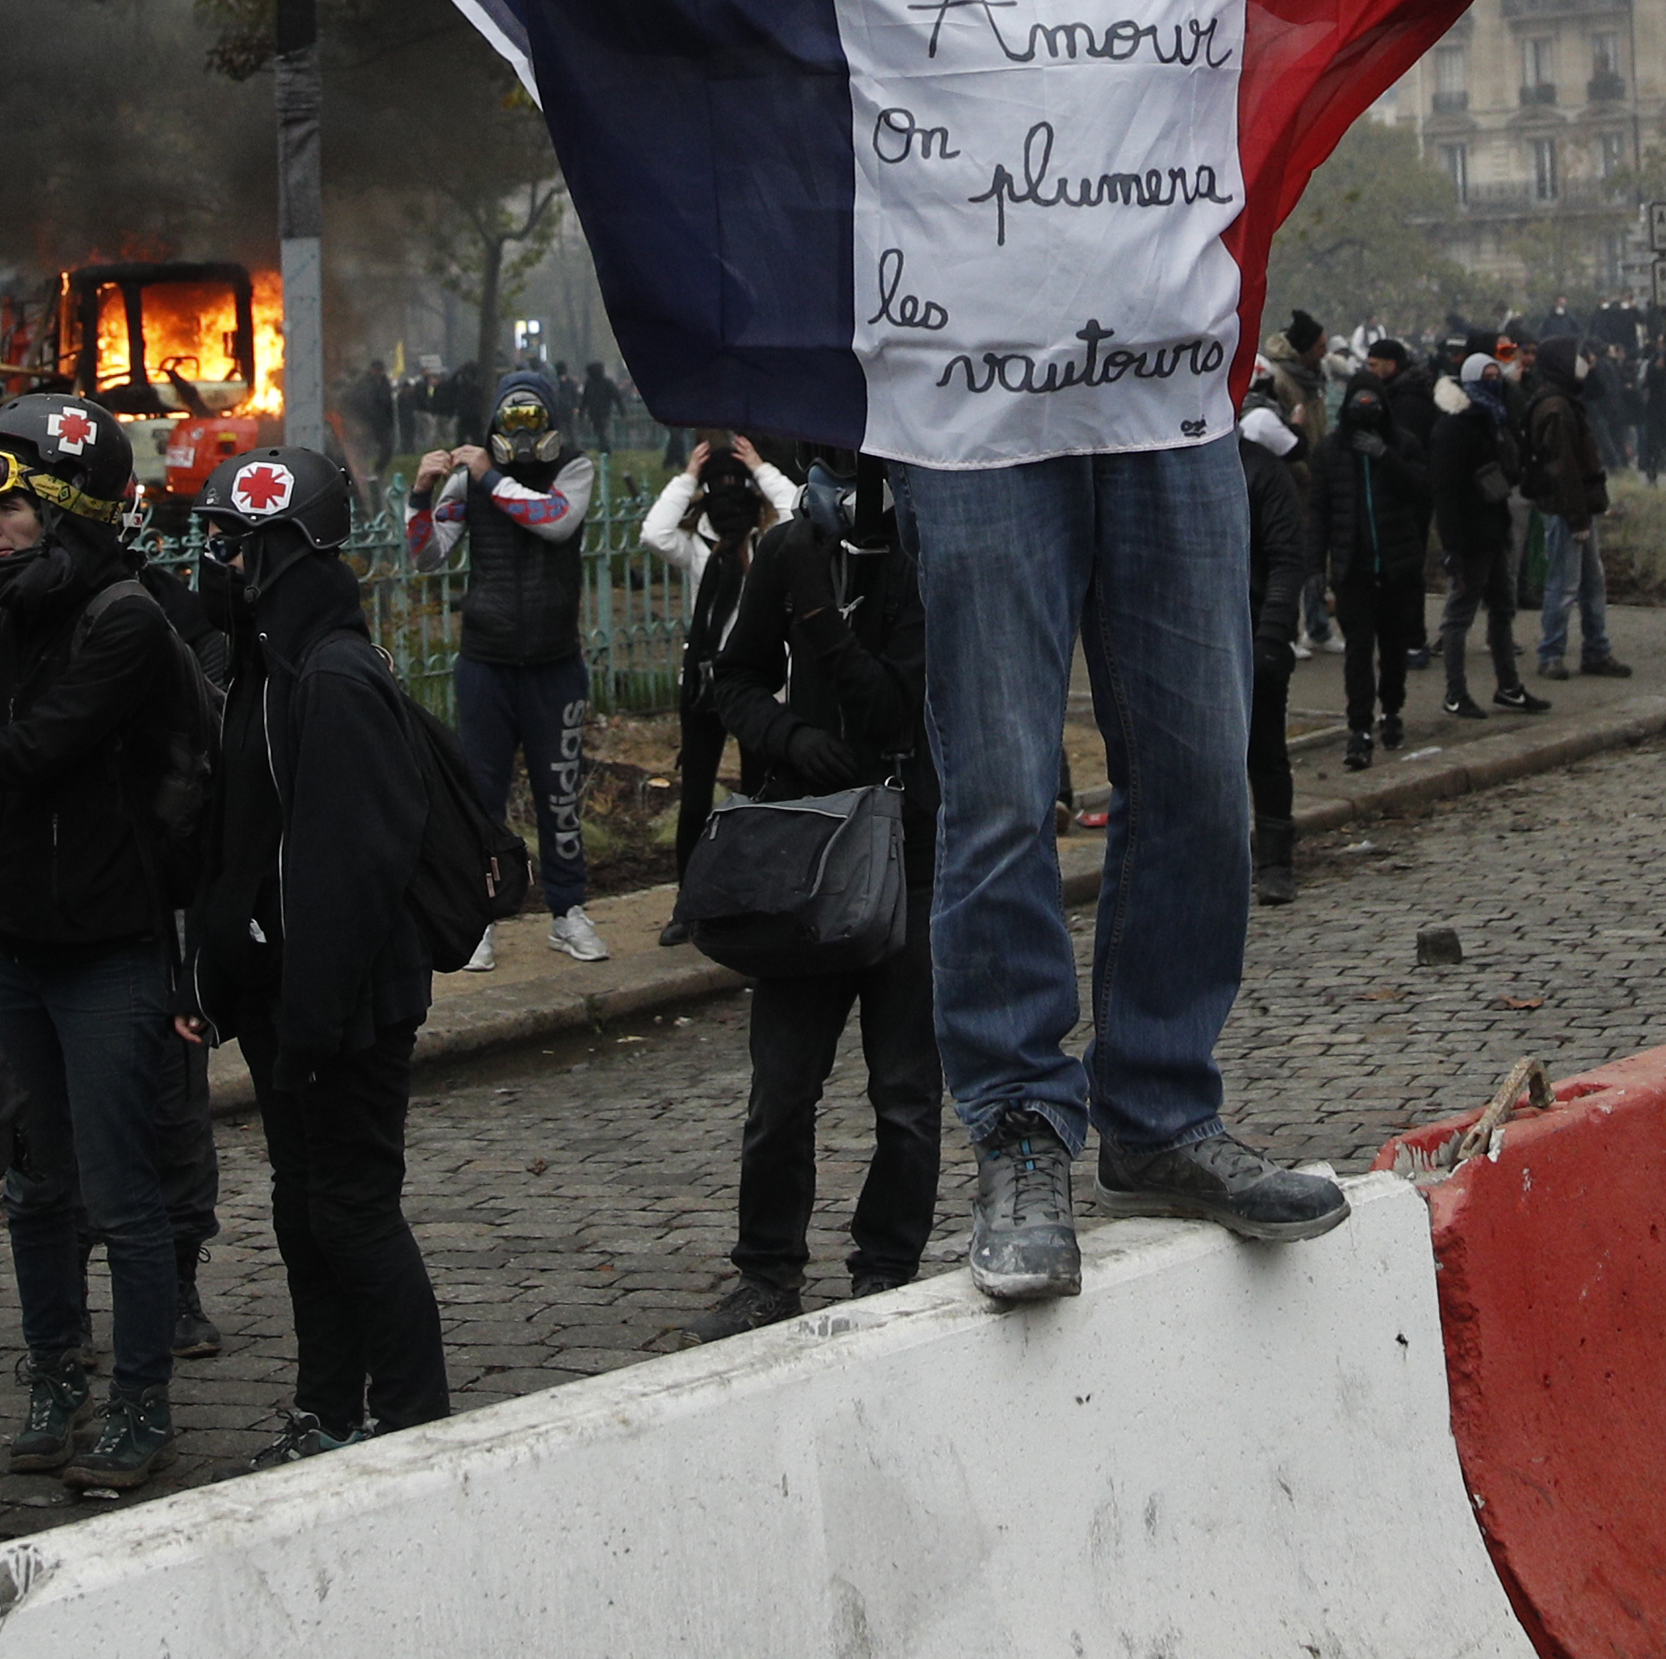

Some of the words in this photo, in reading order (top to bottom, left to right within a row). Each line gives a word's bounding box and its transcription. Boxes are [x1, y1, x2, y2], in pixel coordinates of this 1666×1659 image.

[968, 120, 1234, 247] plumera
[867, 248, 949, 332] les
[936, 317, 1224, 395] vautours
[549, 699, 587, 860] adidas
